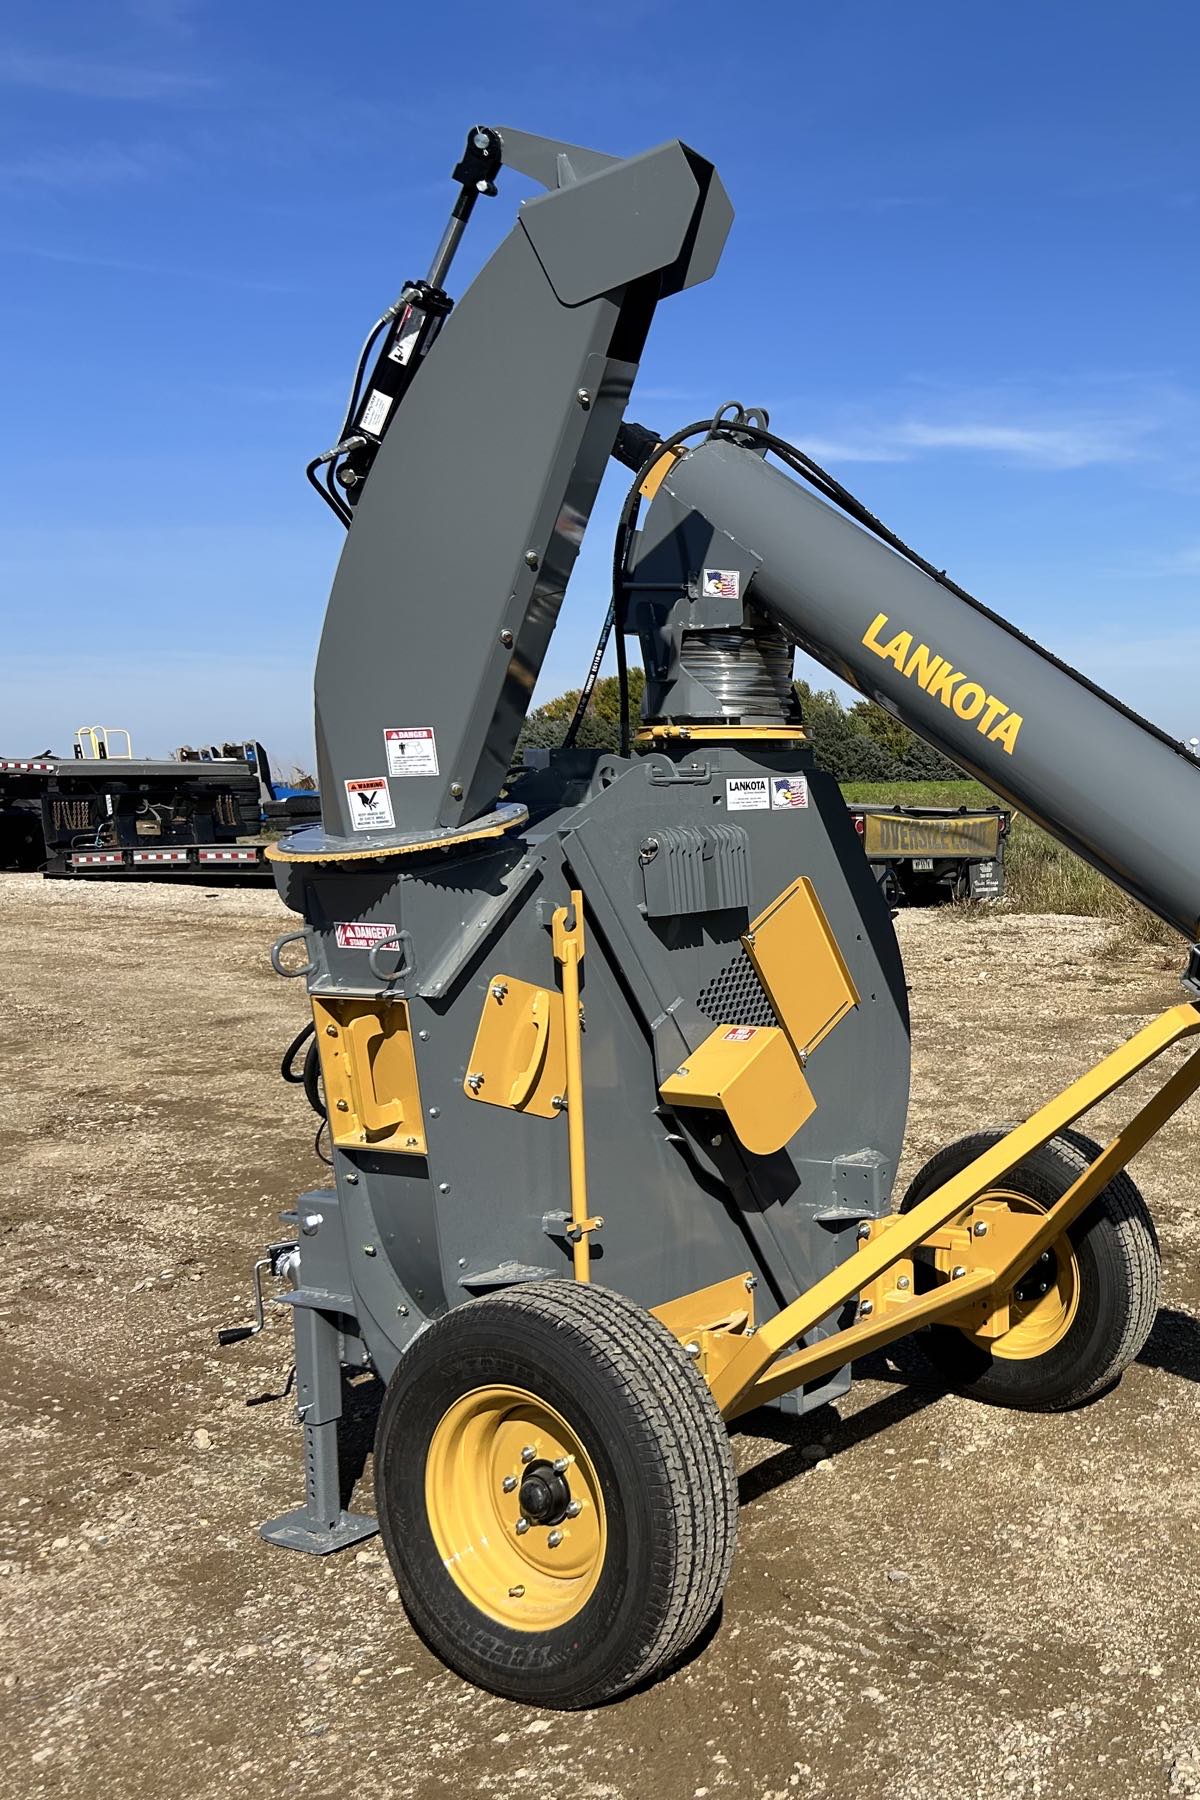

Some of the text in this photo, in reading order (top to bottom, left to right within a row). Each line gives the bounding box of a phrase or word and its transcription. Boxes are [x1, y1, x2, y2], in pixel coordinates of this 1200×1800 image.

[861, 612, 1024, 756] LANKOTA
[398, 730, 428, 739] DANGER
[357, 781, 383, 790] WARNING
[729, 780, 766, 792] LANKOTA
[880, 820, 950, 850] OVERSIZE
[354, 926, 388, 939] DANGER
[349, 938, 368, 946] STAND
